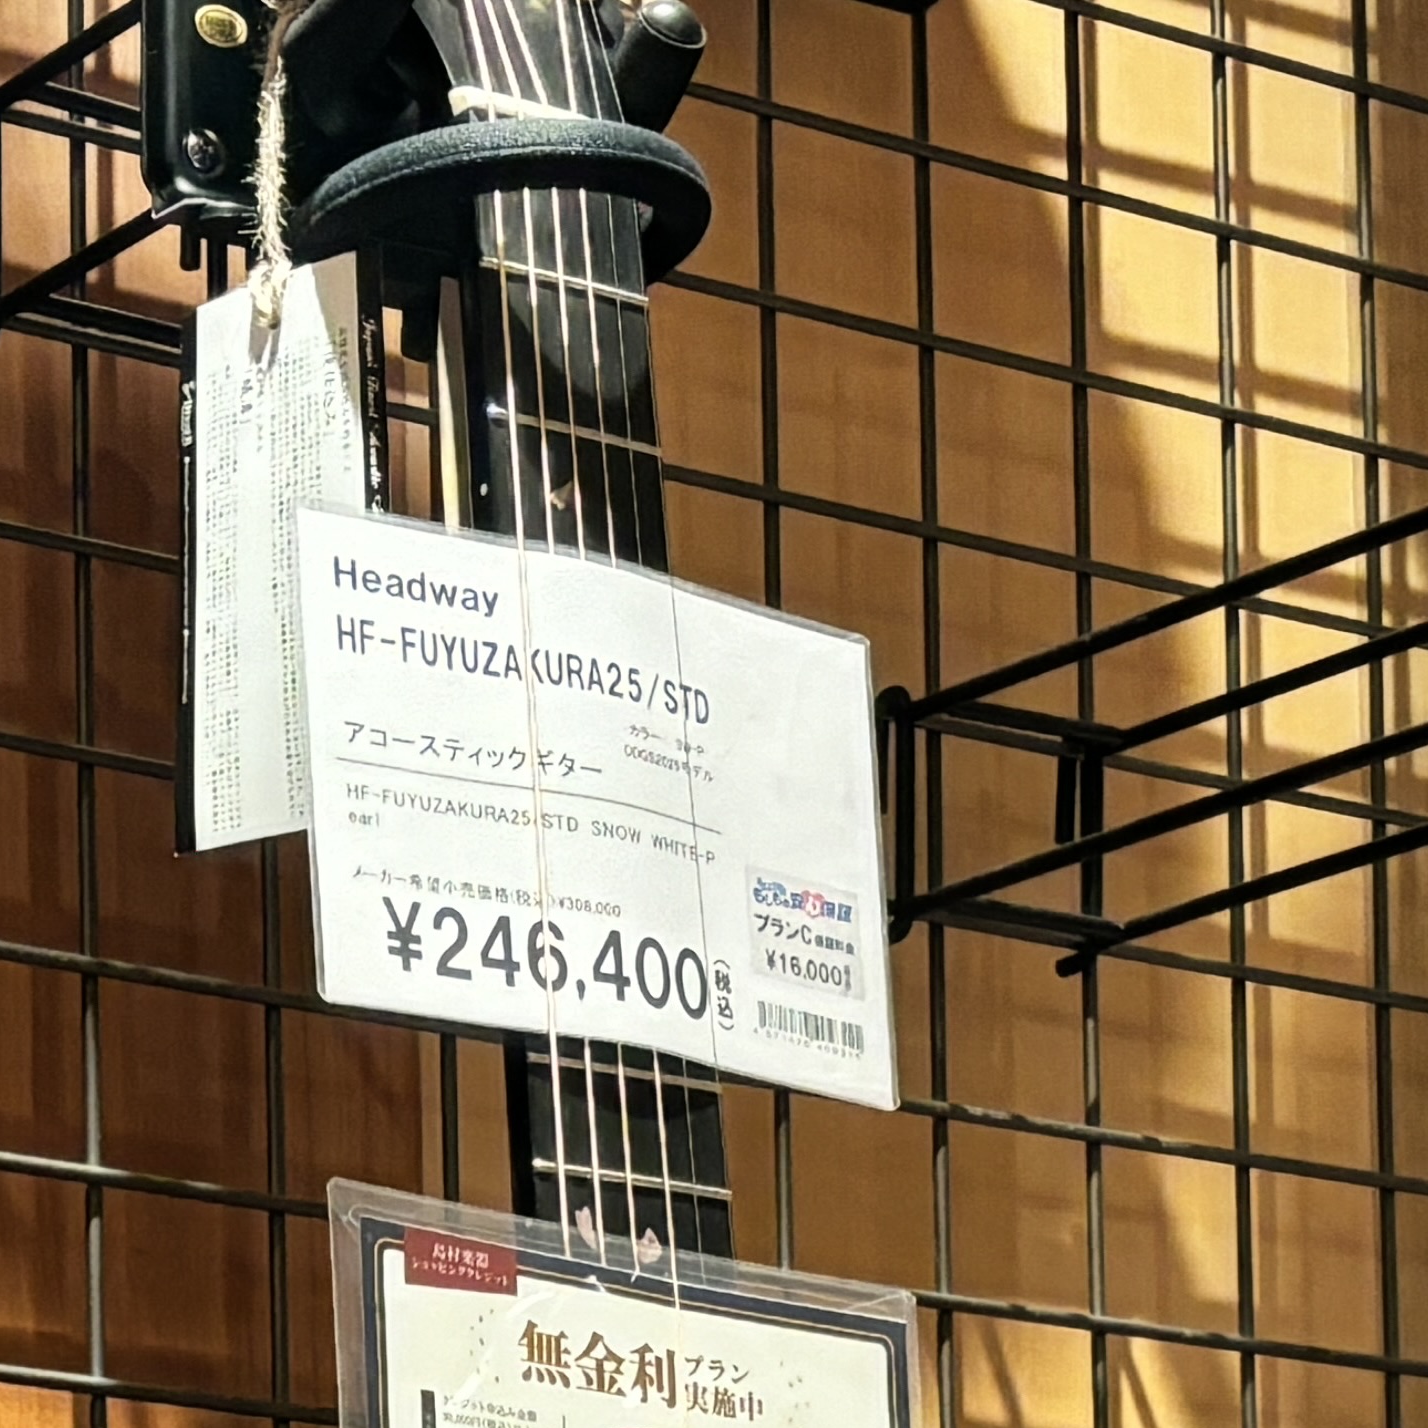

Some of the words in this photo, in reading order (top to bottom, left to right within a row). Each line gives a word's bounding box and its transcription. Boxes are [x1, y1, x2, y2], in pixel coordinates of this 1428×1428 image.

[333, 556, 500, 619] Headway
[335, 612, 710, 725] HF-FUYUZAKURA25/STD
[343, 719, 602, 777] アコースティックギター
[347, 783, 579, 832] HF-FUYUZAKURA25STD
[592, 820, 641, 844] SNOW
[382, 897, 710, 1020] ¥246,400
[518, 1319, 676, 1409] 無金利
[686, 1354, 750, 1383] プラン
[686, 1382, 763, 1422] 実施中
